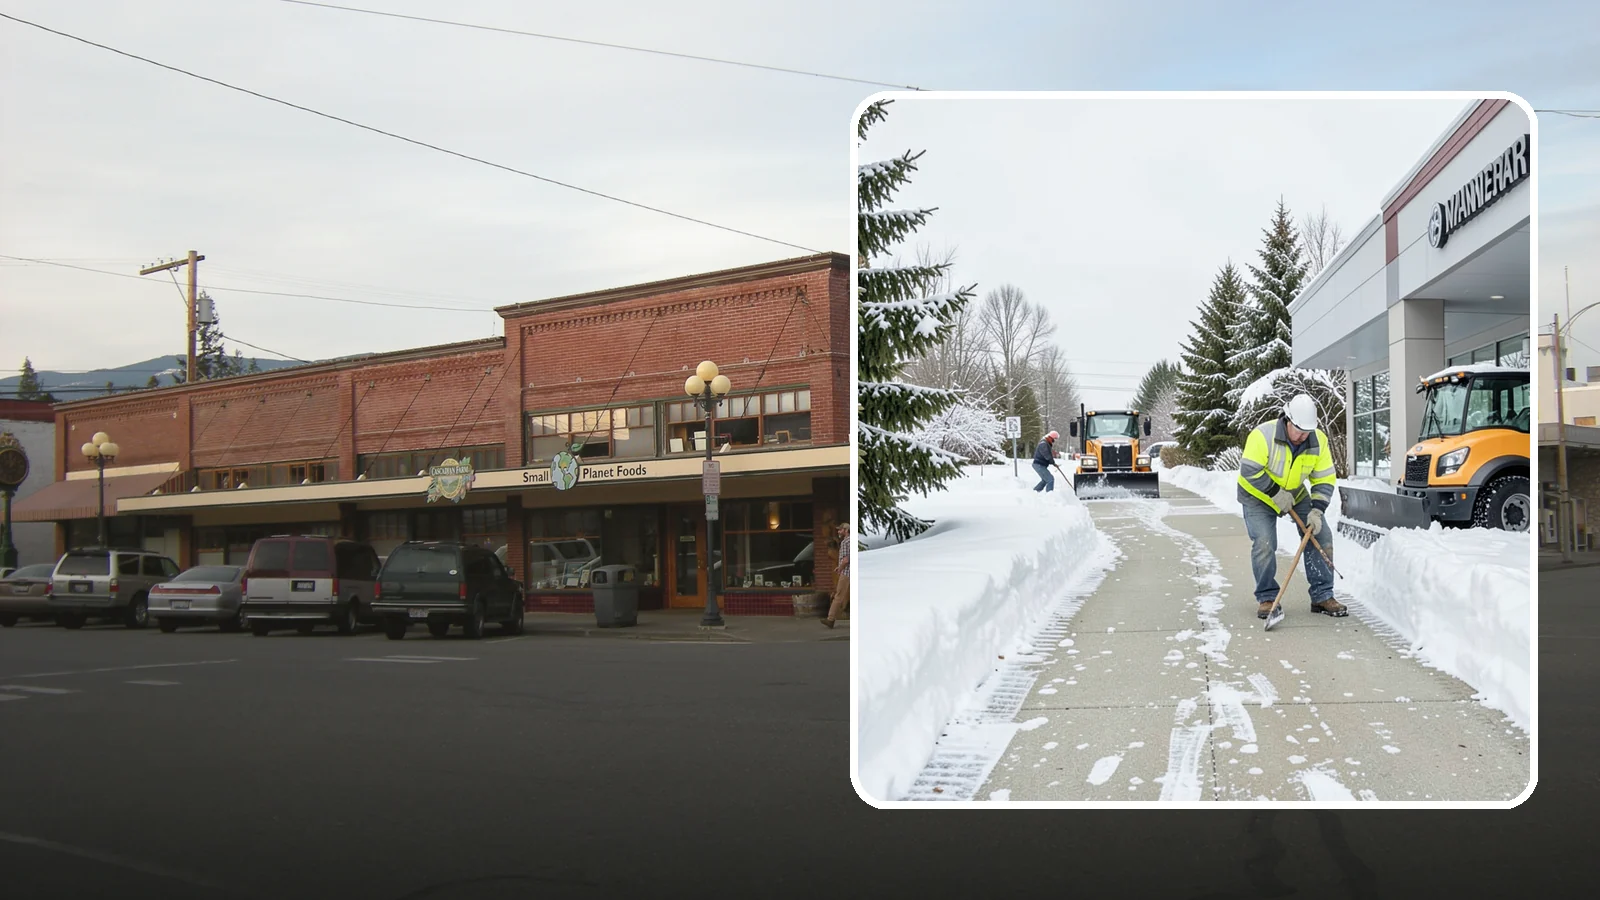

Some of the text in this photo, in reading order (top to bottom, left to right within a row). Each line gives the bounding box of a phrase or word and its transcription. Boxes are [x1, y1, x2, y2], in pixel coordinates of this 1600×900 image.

[431, 465, 469, 476] CASCADIAN FARM
[522, 464, 647, 483] Small Planet Foods
